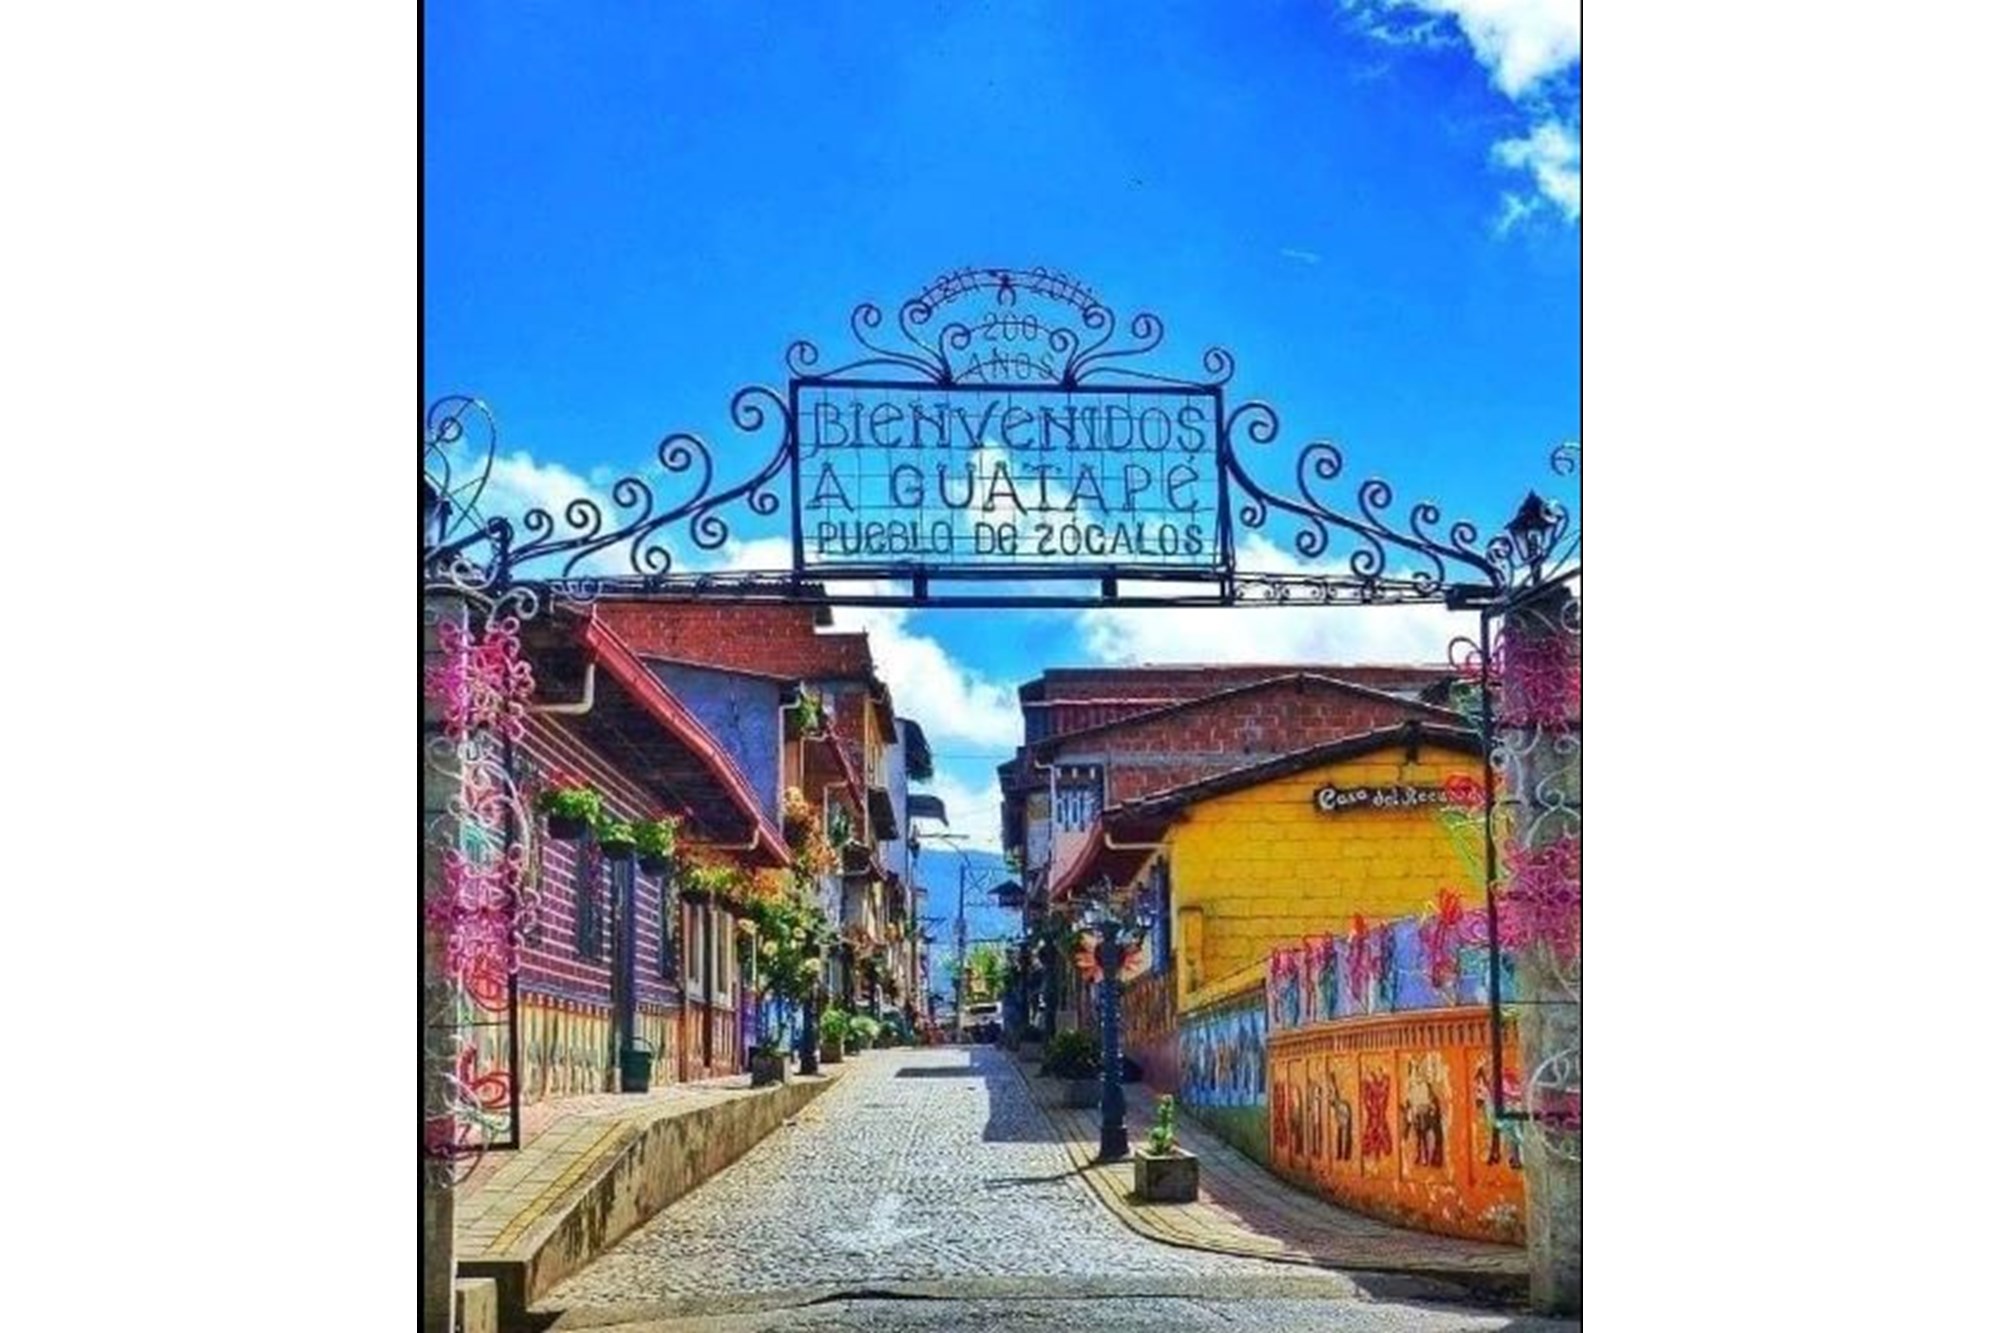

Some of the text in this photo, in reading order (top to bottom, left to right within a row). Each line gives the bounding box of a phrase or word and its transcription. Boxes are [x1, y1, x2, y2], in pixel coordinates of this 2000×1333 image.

[983, 311, 1038, 341] 200
[812, 400, 1206, 454] BIENVENIDOS
[807, 456, 1202, 513] A GUATAPÉ
[816, 522, 953, 556] PUEBLO
[974, 523, 1018, 555] DE
[1319, 787, 1367, 811] Casa
[1373, 788, 1398, 806] del
